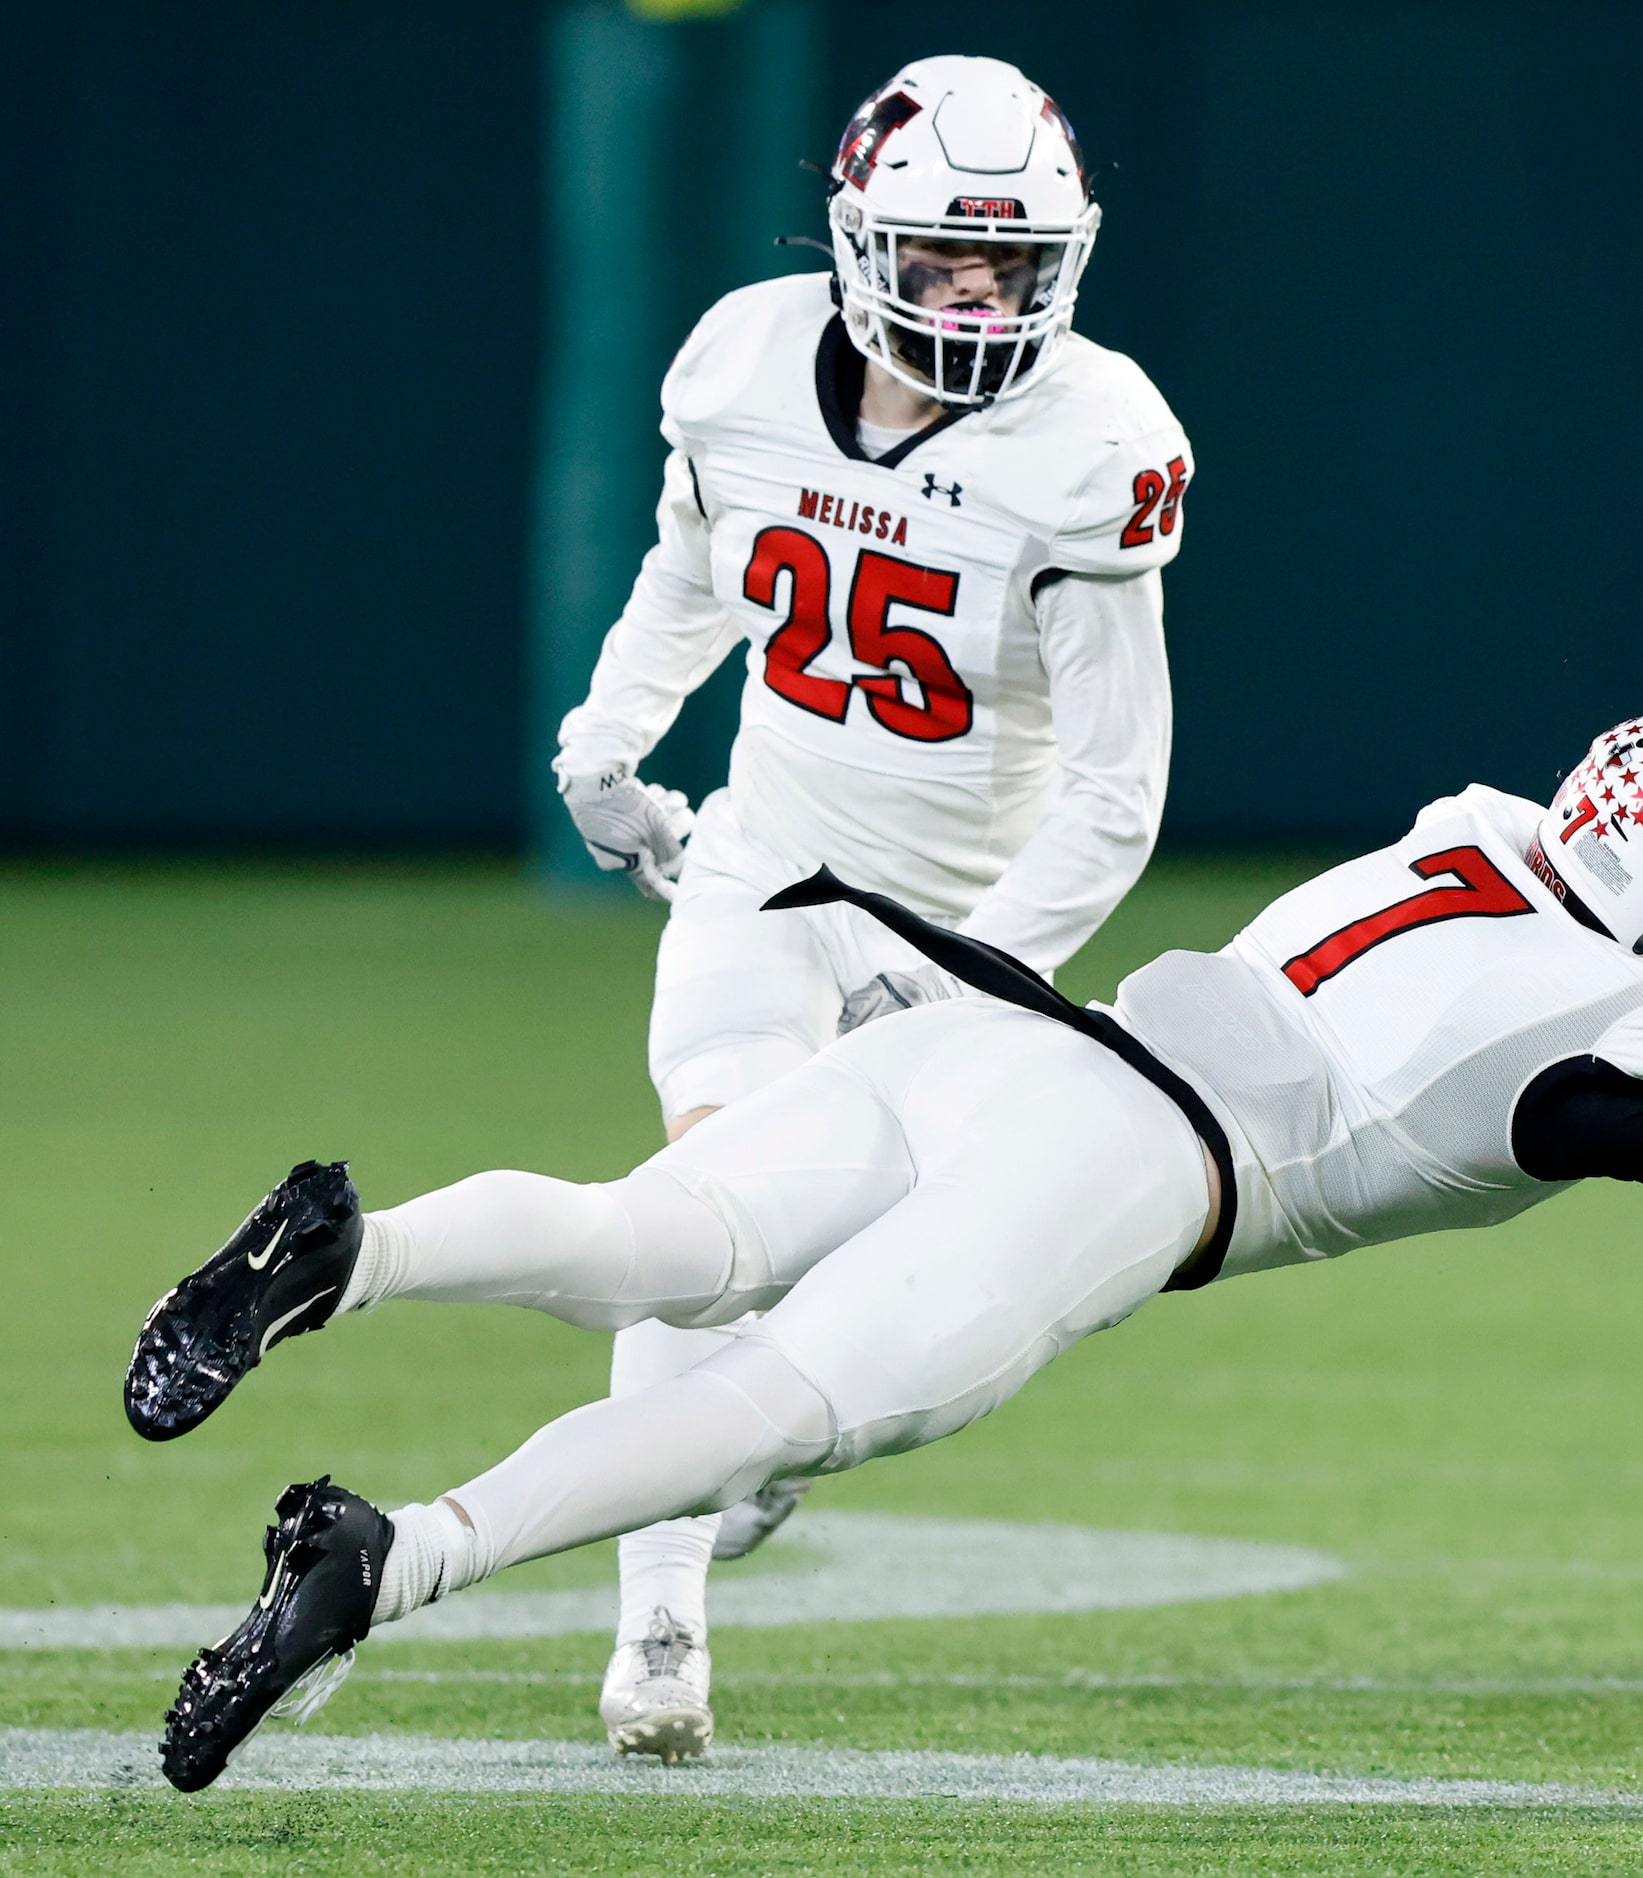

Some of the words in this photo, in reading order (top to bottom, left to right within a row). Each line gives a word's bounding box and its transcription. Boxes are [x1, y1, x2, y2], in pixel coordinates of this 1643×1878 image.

[798, 488, 909, 546] MELISSA
[1120, 455, 1187, 549] 25
[743, 526, 974, 743] 25
[1559, 794, 1599, 845] 7
[1281, 845, 1538, 998] 7
[360, 1549, 372, 1587] VAPOR
